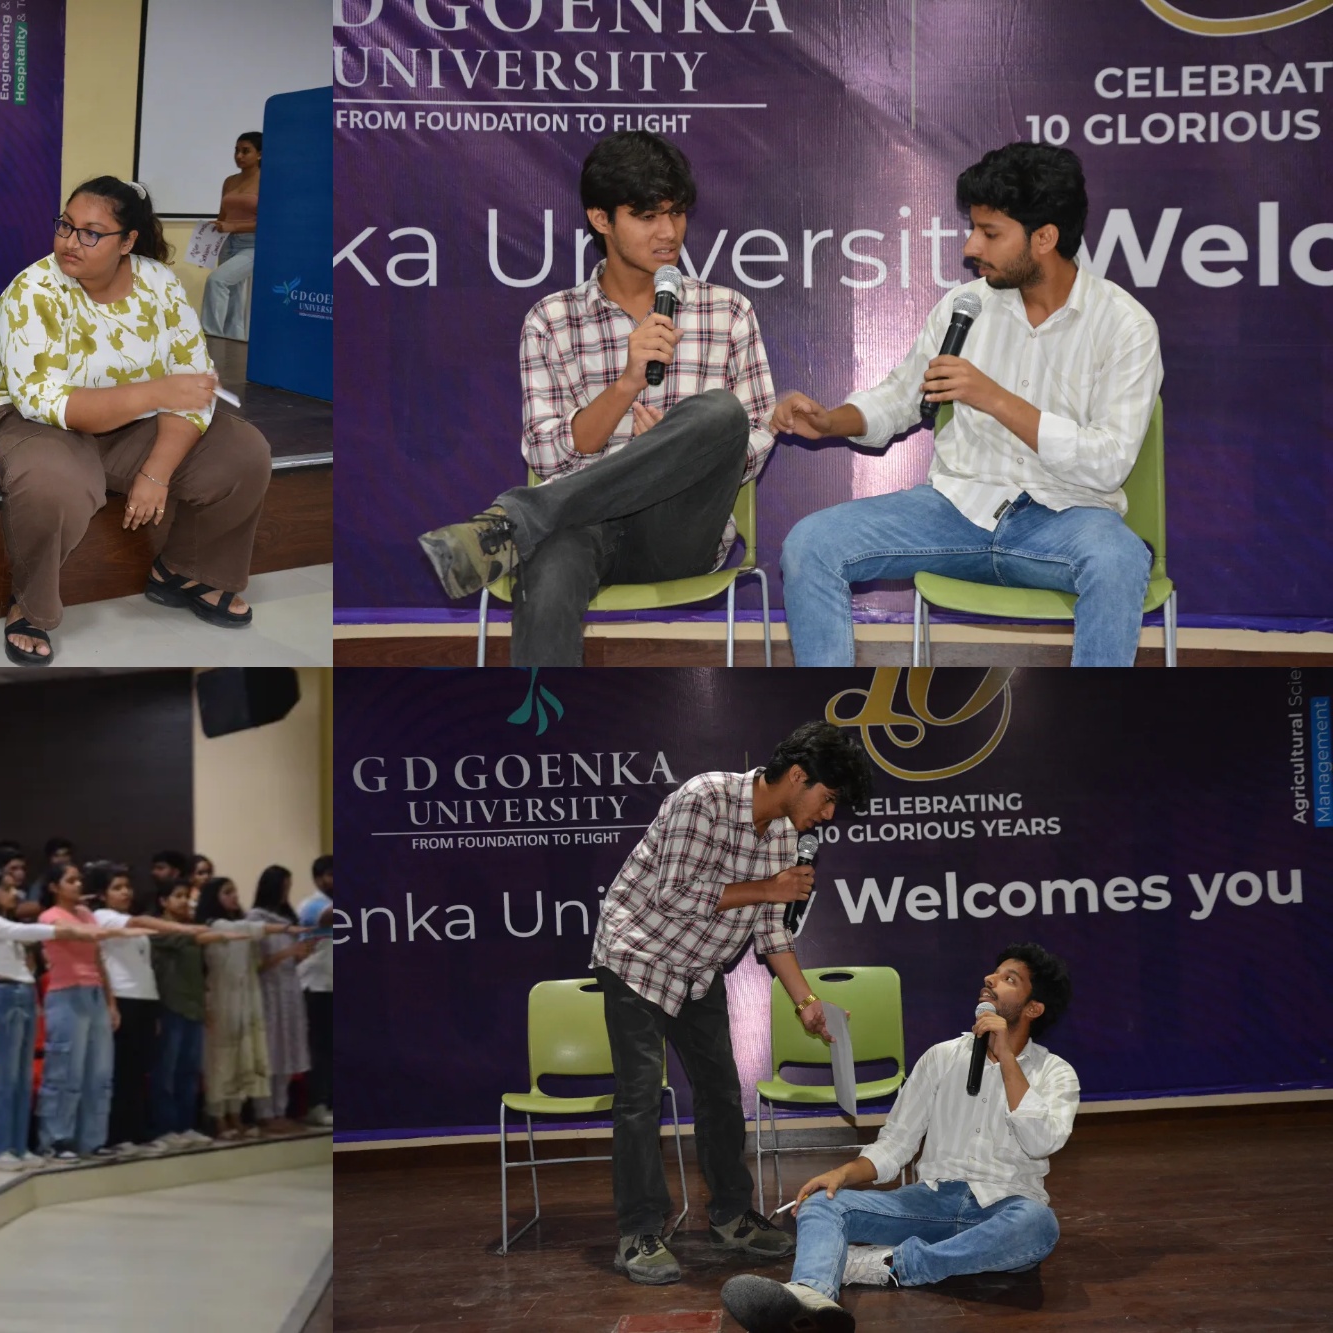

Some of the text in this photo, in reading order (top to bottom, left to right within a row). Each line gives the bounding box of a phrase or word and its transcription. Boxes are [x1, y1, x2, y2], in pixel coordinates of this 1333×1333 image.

[17, 13, 26, 22] &
[0, 1, 12, 100] Engineering &
[15, 26, 27, 102] Hospitality
[333, 46, 708, 93] UNIVERSITY
[1094, 61, 1333, 99] CELEBRAT
[336, 110, 692, 134] FROM FOUNDATION TO FLIGHT
[1025, 108, 1321, 146] 10 GLORIOUS
[299, 291, 307, 301] D
[352, 751, 678, 792] G D GOENKA
[1288, 713, 1309, 824] Agricultural
[1314, 700, 1333, 822] Management
[407, 795, 628, 826] UNIVERSITY
[853, 793, 1023, 817] ELEBRATING
[412, 832, 621, 850] FROM FOUNDATION TO FLIGHT
[815, 816, 1061, 844] 10 GLORIOUS YEARS
[834, 872, 1172, 924] Welcomes
[1187, 868, 1303, 921] you
